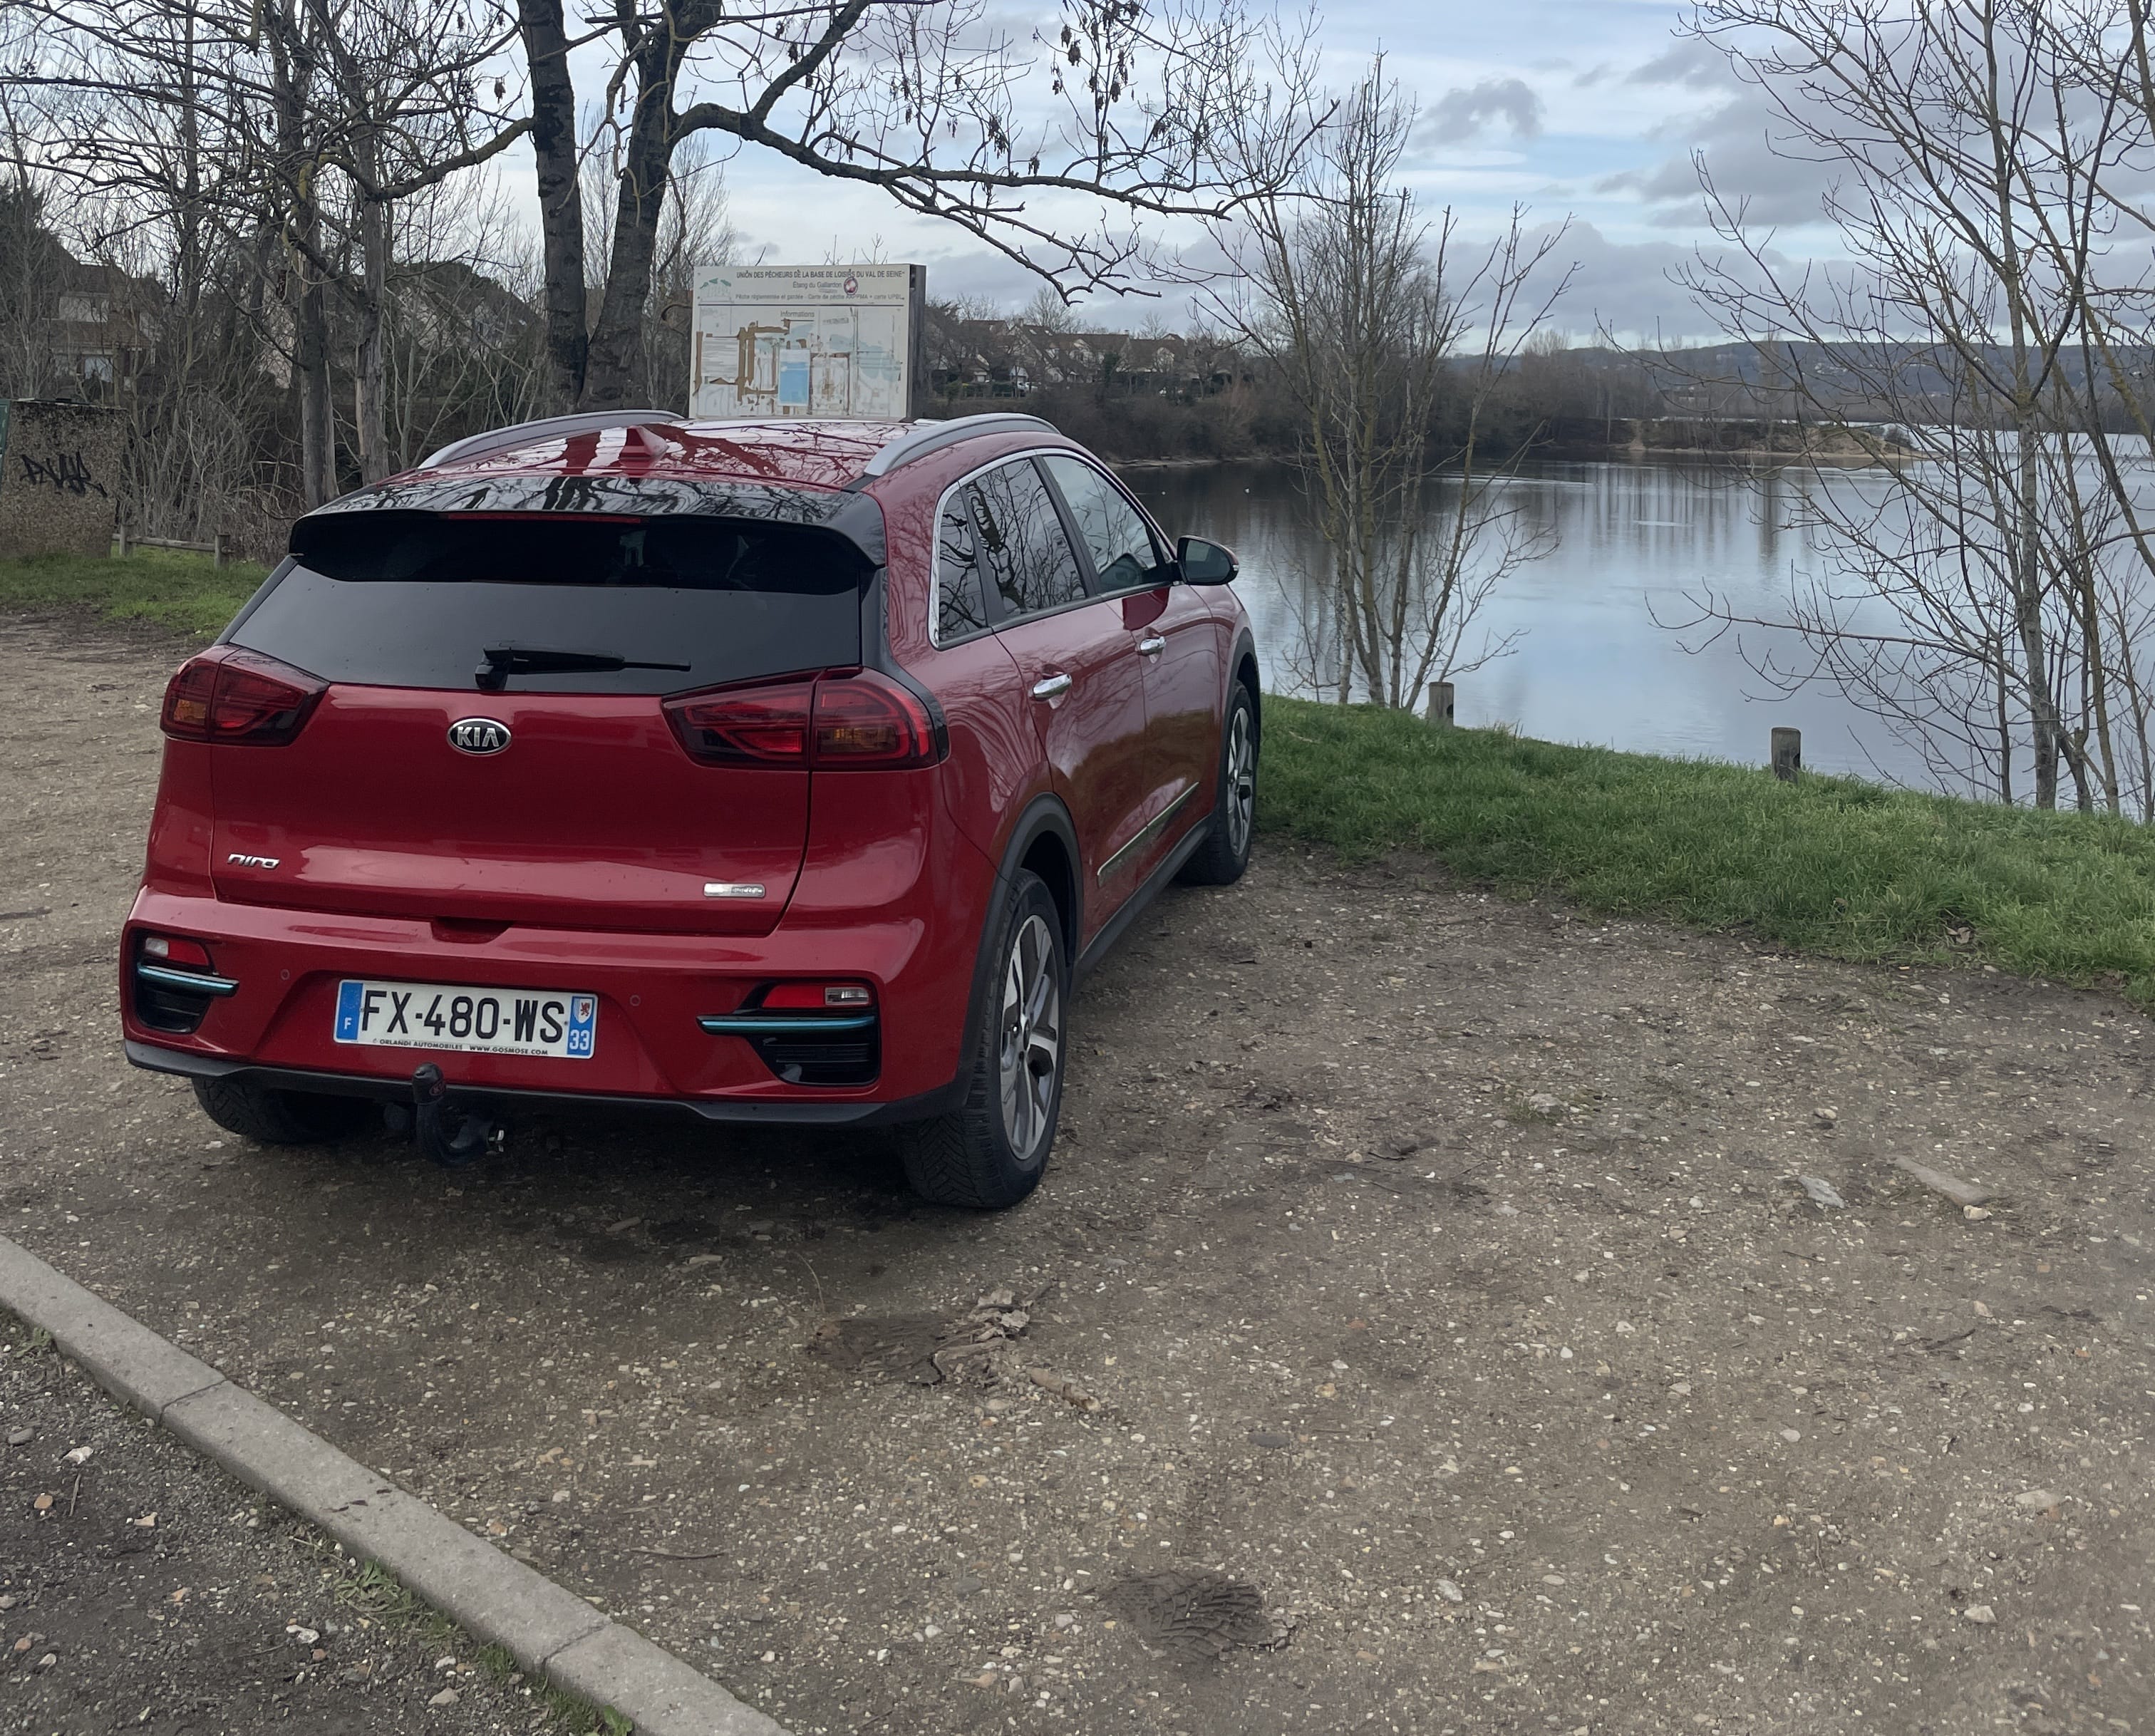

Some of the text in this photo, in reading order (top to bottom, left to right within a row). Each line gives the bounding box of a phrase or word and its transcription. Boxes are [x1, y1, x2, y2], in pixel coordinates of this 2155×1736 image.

[457, 726, 500, 747] KIA
[343, 1017, 352, 1030] F
[361, 990, 564, 1043] FX-480-WS
[379, 1038, 411, 1047] ORLANDI
[413, 1041, 462, 1050] AUTOMOBILES
[569, 1029, 589, 1051] 33
